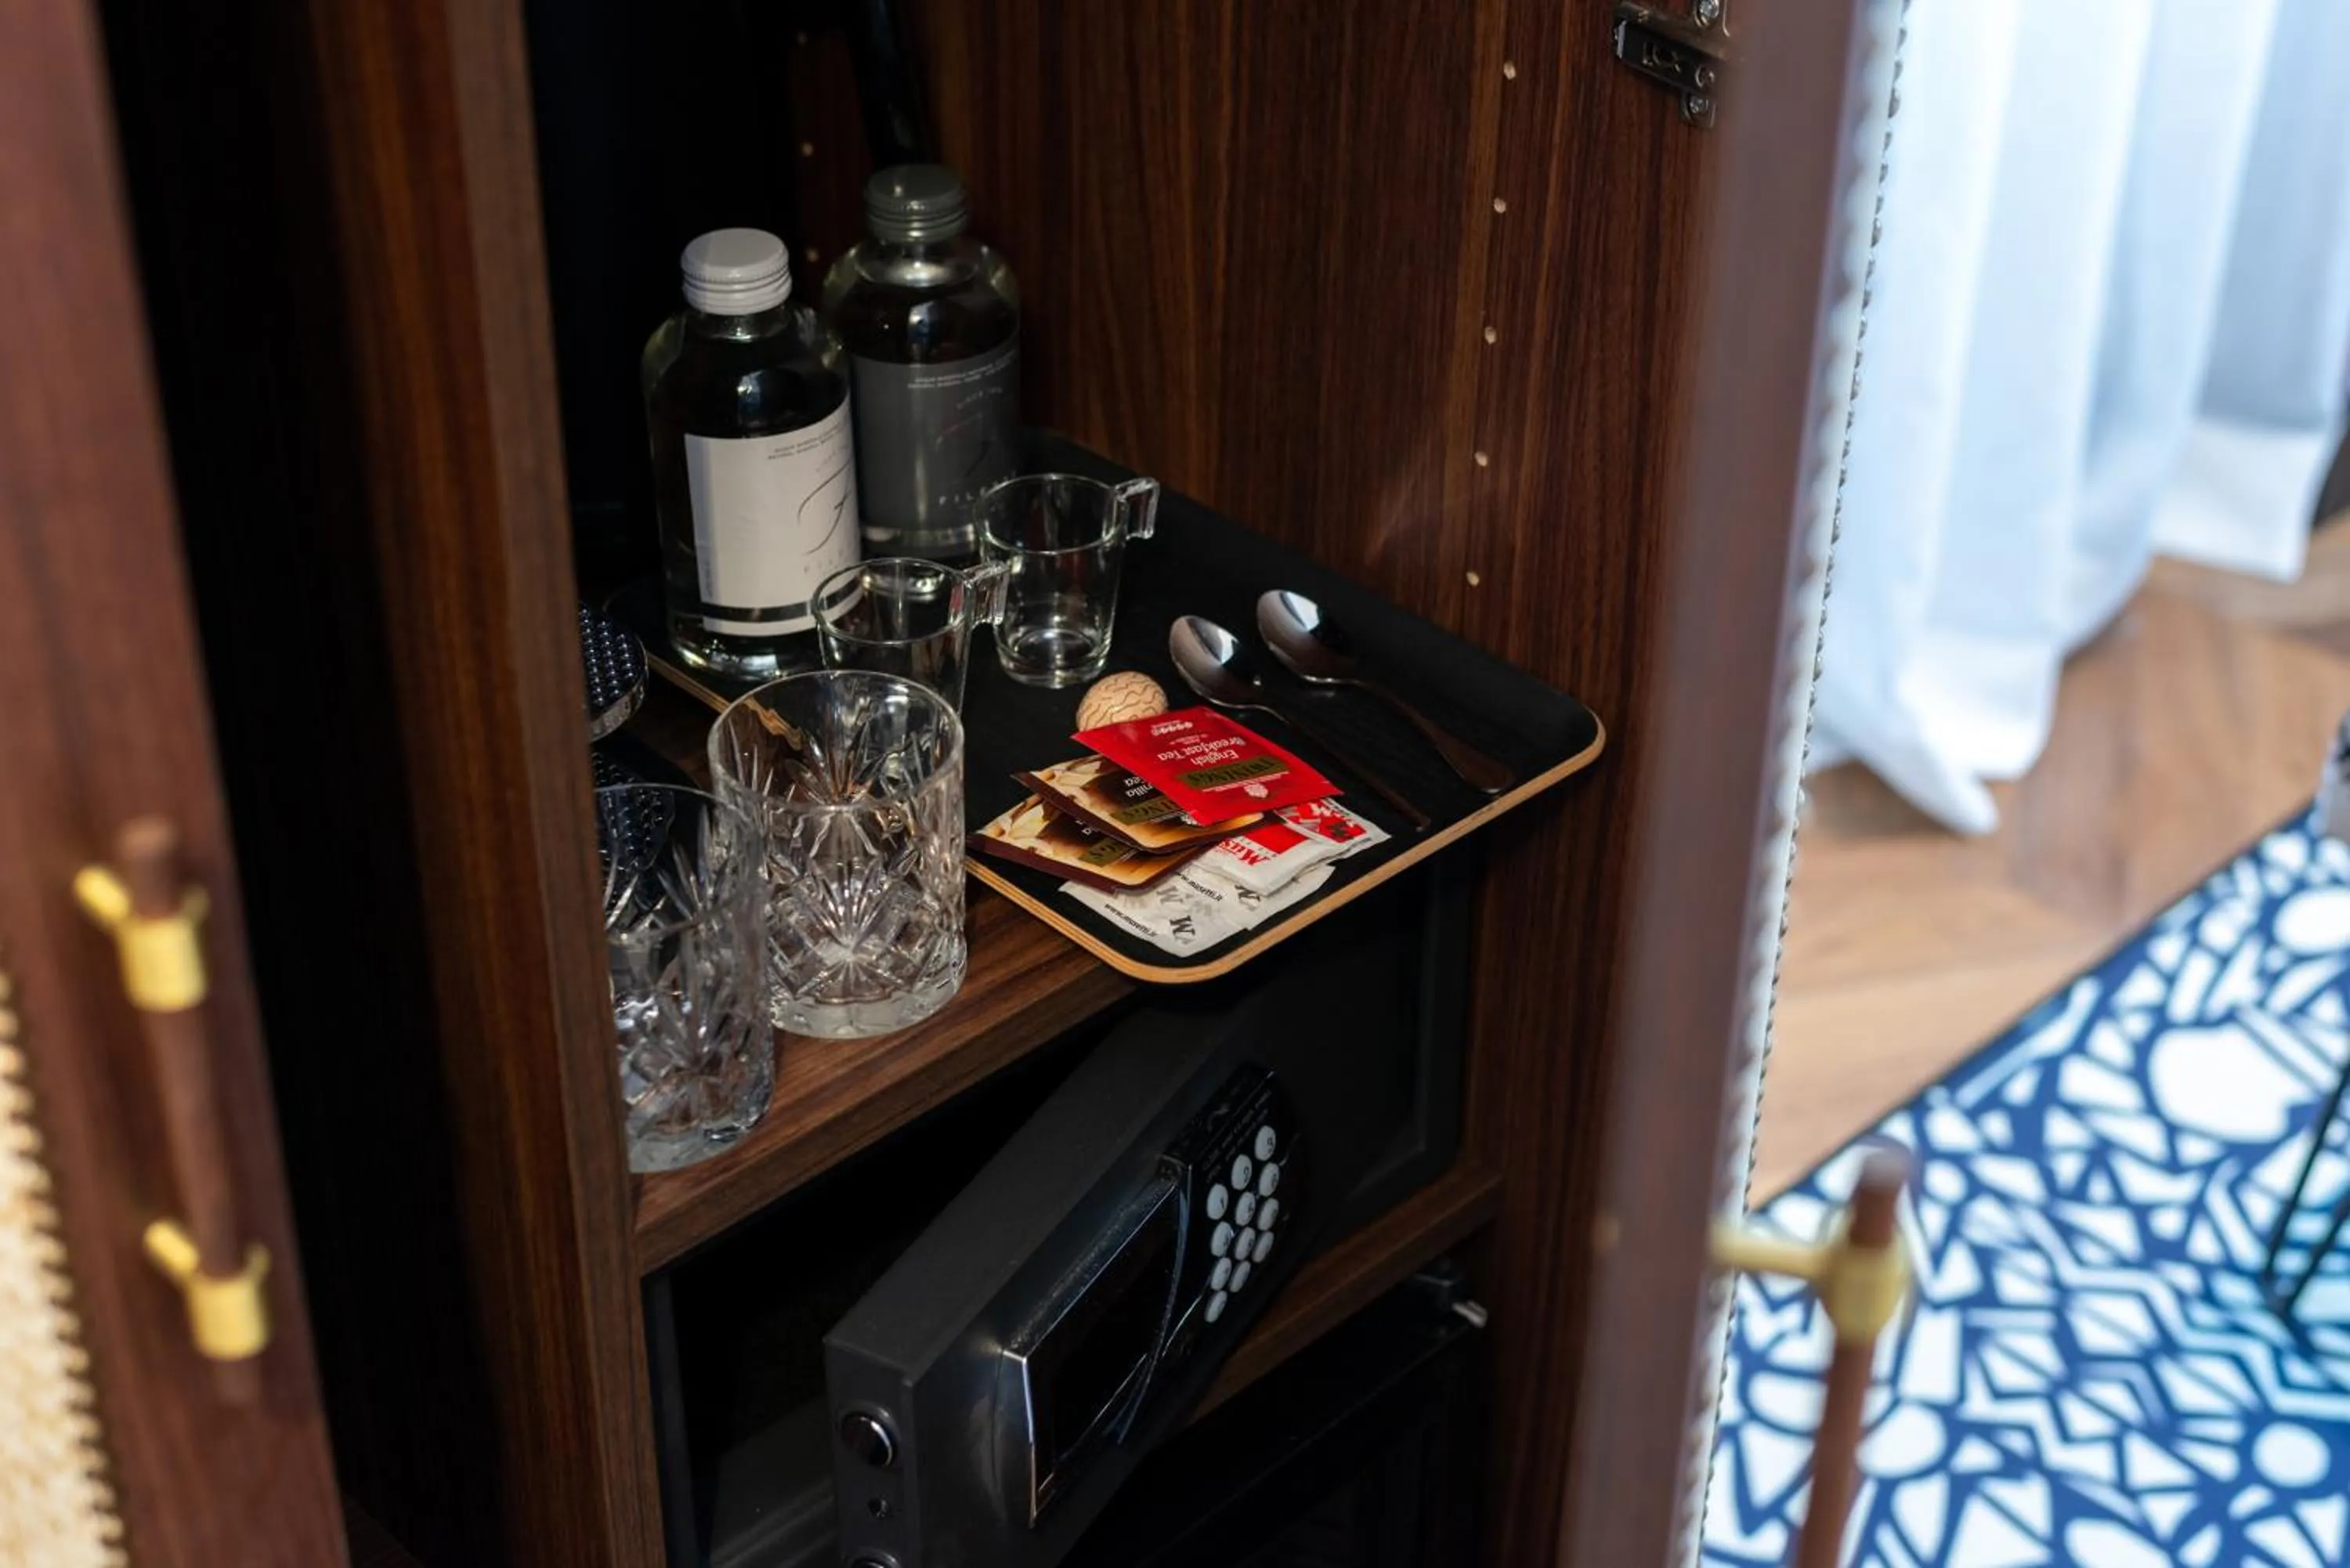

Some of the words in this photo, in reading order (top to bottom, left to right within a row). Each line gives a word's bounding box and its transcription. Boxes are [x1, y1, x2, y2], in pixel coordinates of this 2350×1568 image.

[1157, 748, 1185, 762] Tea
[1185, 735, 1247, 758] Breakfast
[1191, 748, 1239, 768] English
[1125, 783, 1154, 798] nilla
